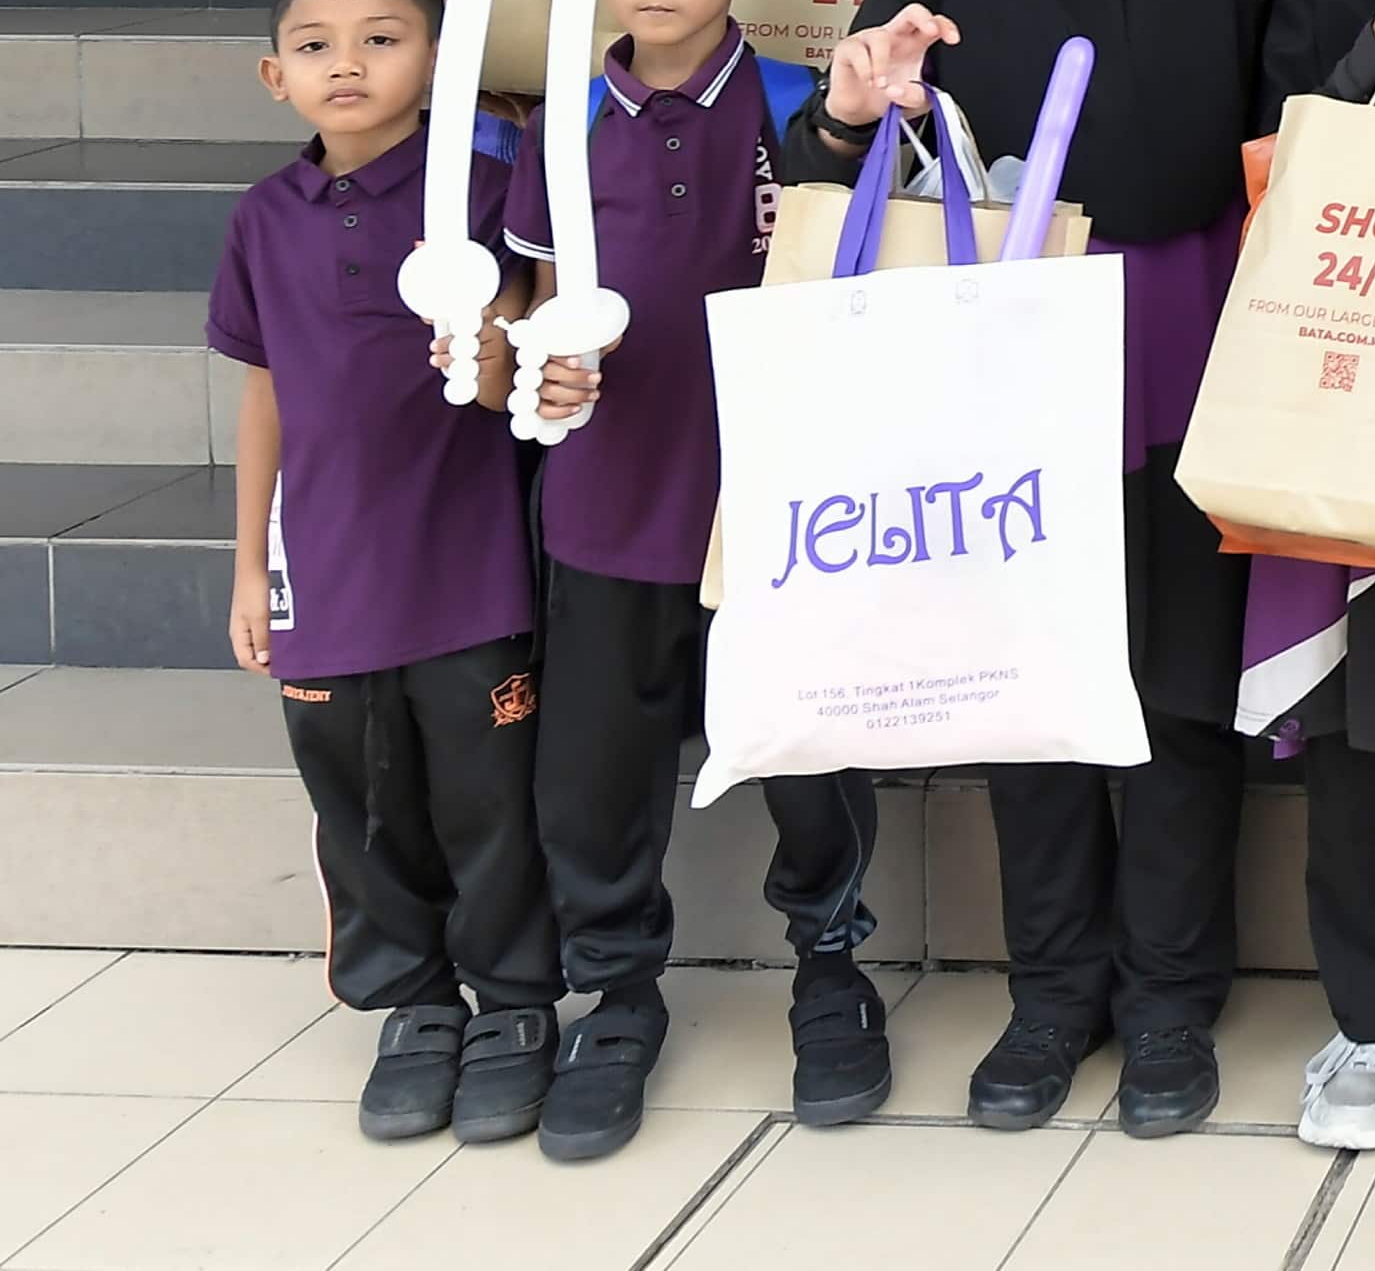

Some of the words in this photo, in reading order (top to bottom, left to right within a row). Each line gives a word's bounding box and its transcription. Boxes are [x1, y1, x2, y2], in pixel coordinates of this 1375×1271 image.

[794, 24, 834, 39] OUR
[1248, 298, 1291, 315] FROM
[1293, 303, 1328, 323] OUR
[771, 467, 1048, 589] JELITA
[854, 680, 904, 700] Tingkat
[978, 667, 1019, 683] PKNS
[816, 704, 859, 718] 40000
[862, 699, 898, 714] Shah
[900, 695, 936, 709] Alam
[938, 687, 1000, 706] Selangor
[866, 710, 951, 730] 0122139251
